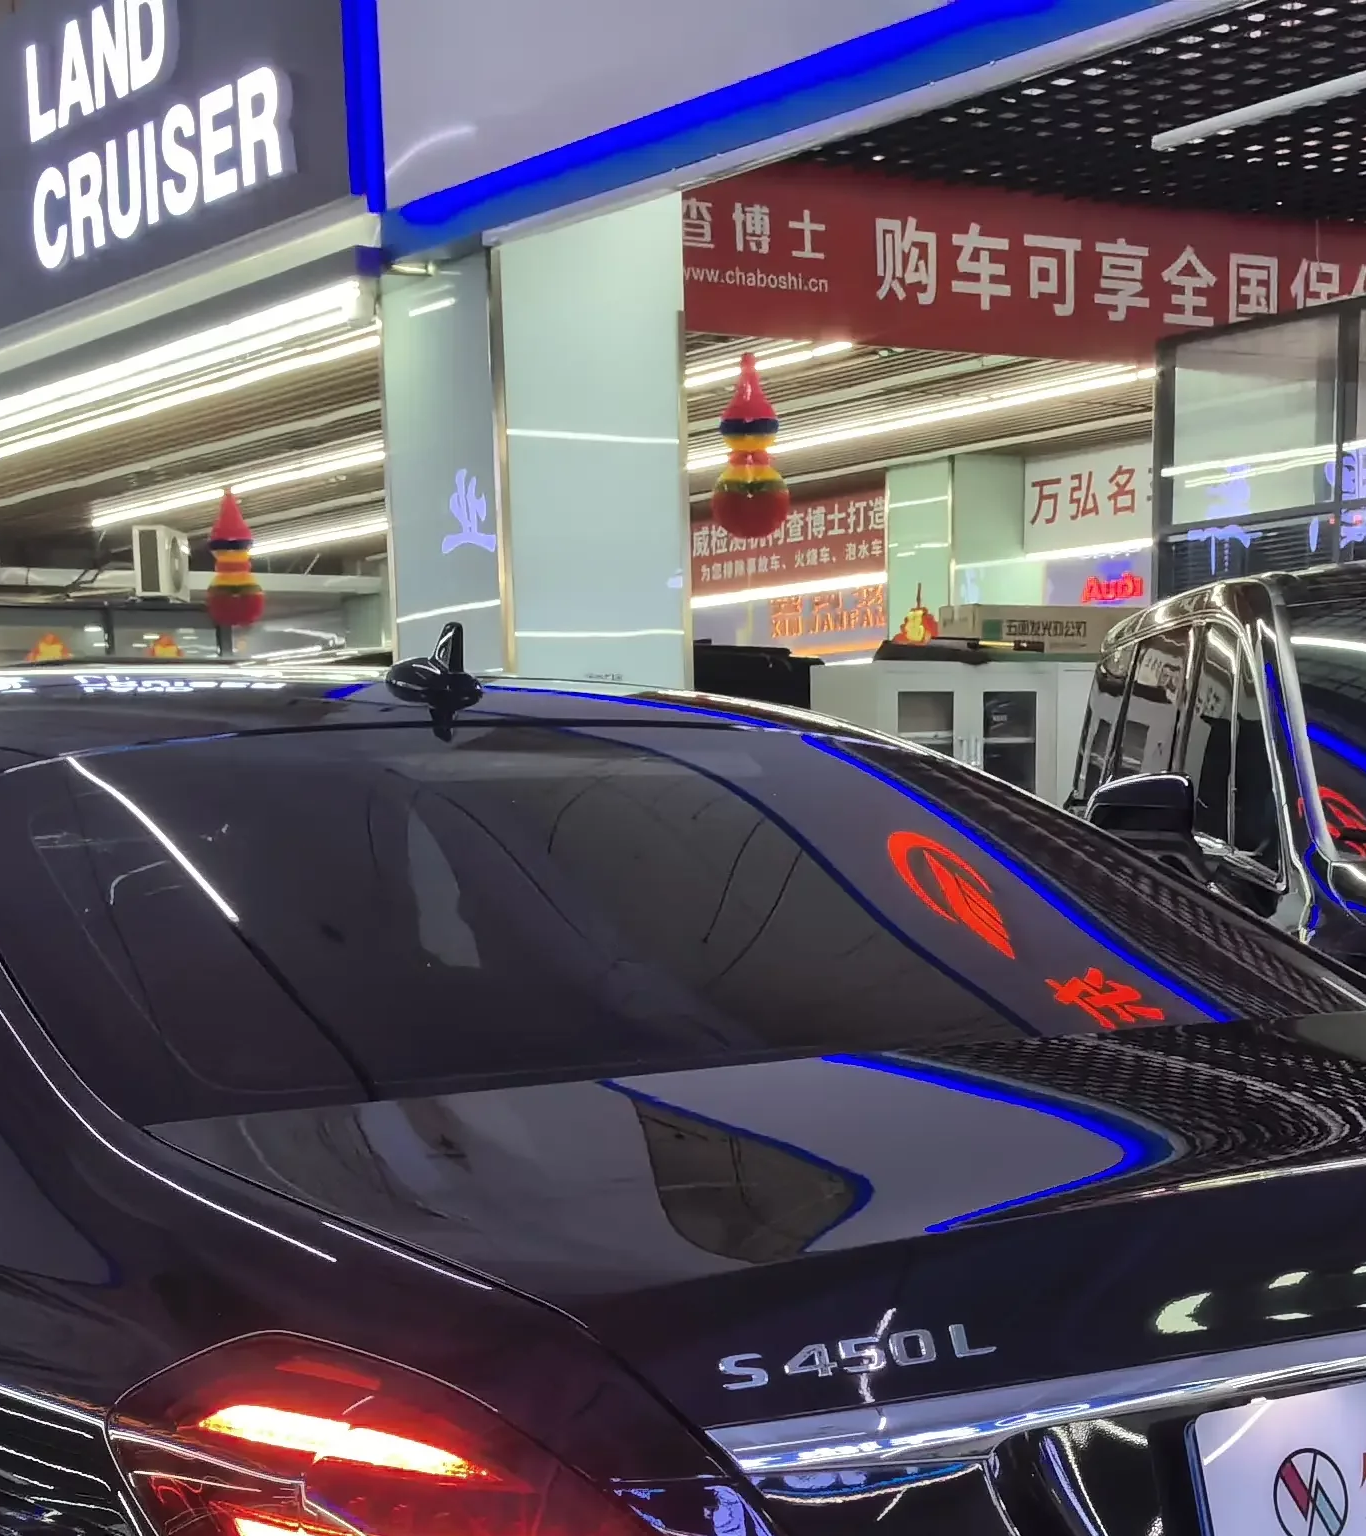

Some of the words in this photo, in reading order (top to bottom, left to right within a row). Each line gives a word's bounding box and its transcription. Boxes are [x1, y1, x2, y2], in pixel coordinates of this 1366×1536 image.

[26, 0, 165, 143] LAND
[33, 66, 283, 269] CRUISER
[682, 197, 826, 260] 查博士
[1029, 464, 1153, 526] 万弘名
[718, 1353, 769, 1391] S
[784, 1328, 936, 1378] 450
[948, 1323, 997, 1358] L
